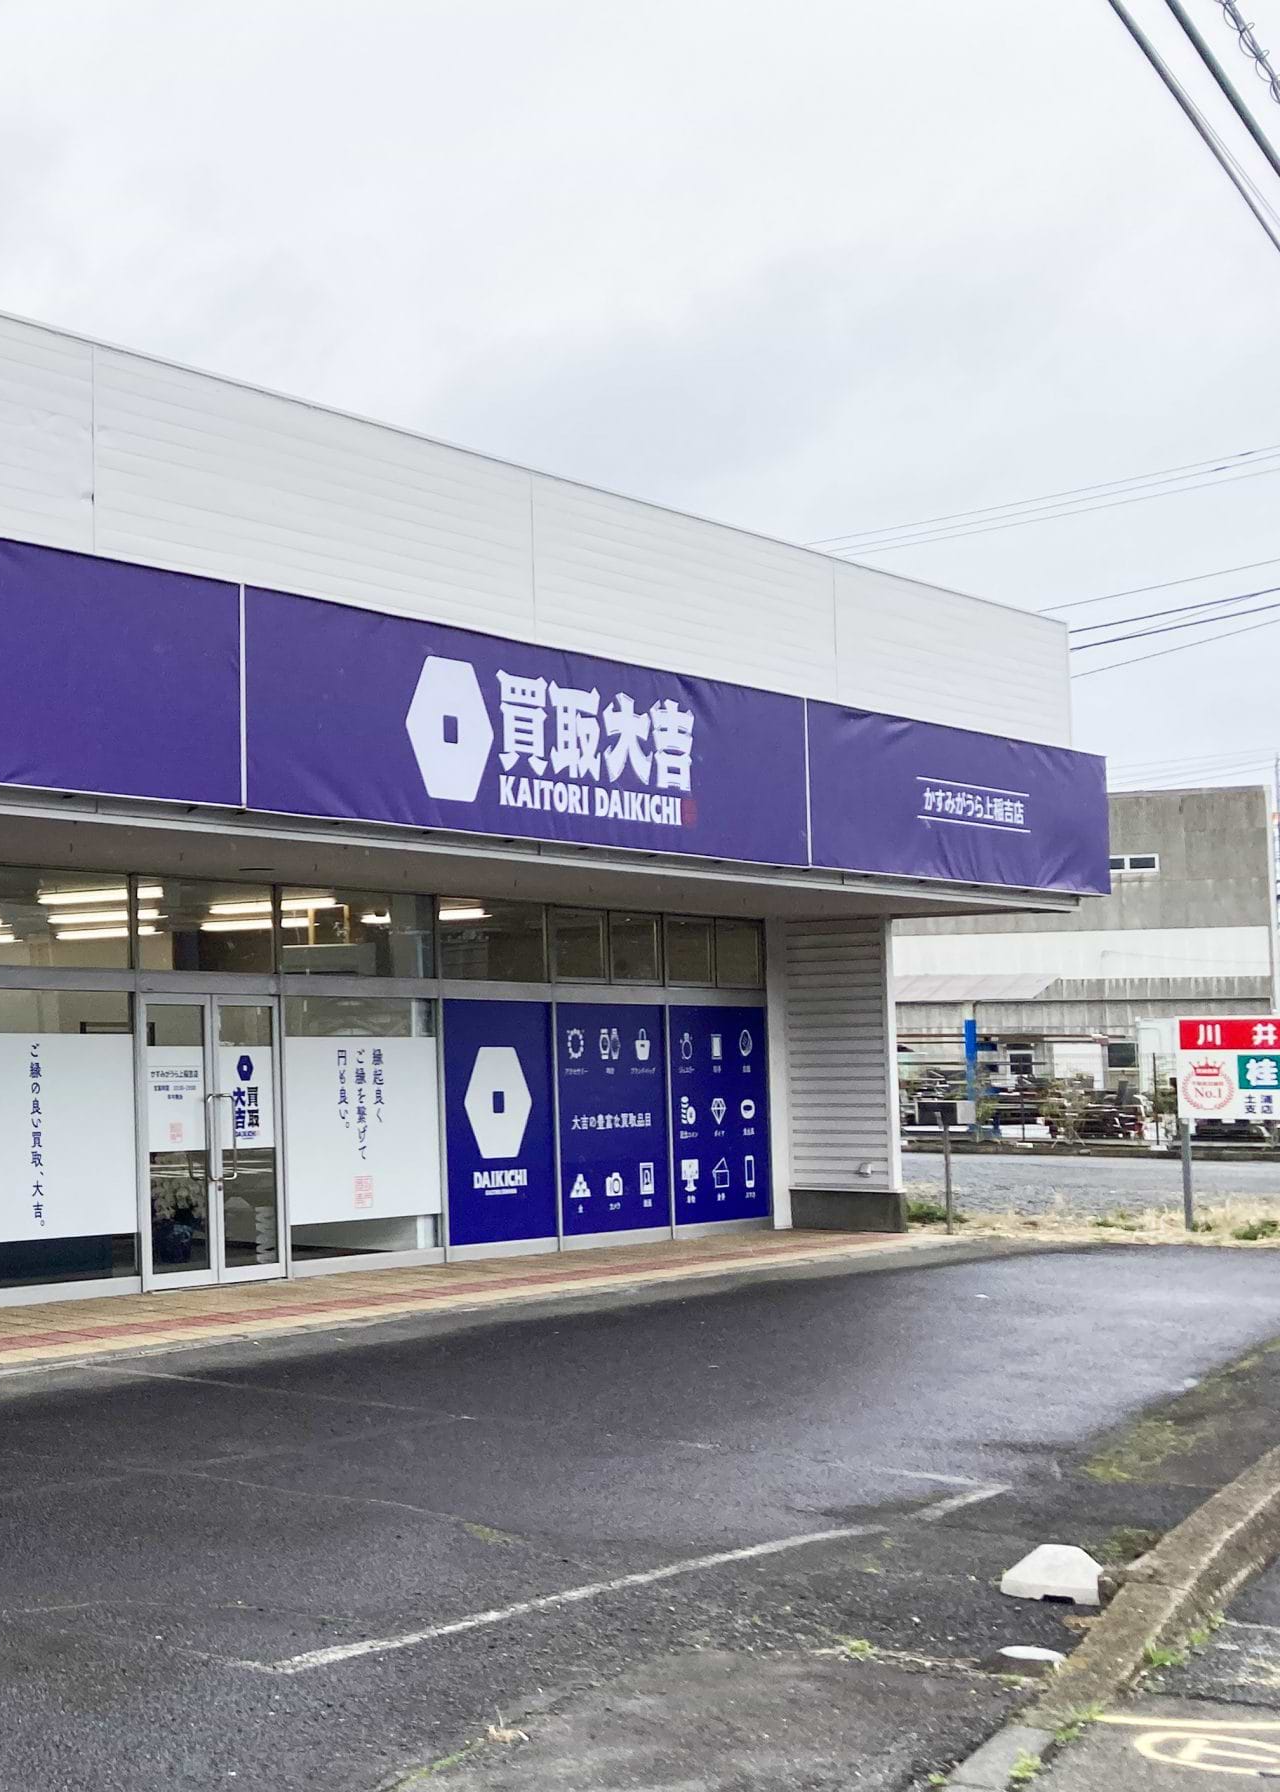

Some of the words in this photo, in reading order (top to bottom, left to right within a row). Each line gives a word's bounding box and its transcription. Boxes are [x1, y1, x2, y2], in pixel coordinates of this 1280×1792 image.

[496, 669, 695, 791] 買取大吉
[499, 774, 589, 816] KAITORI
[594, 786, 682, 825] DAIKICHI
[923, 787, 1024, 825] かすみがうら上稲吉店
[473, 1168, 528, 1189] DAIKICHI
